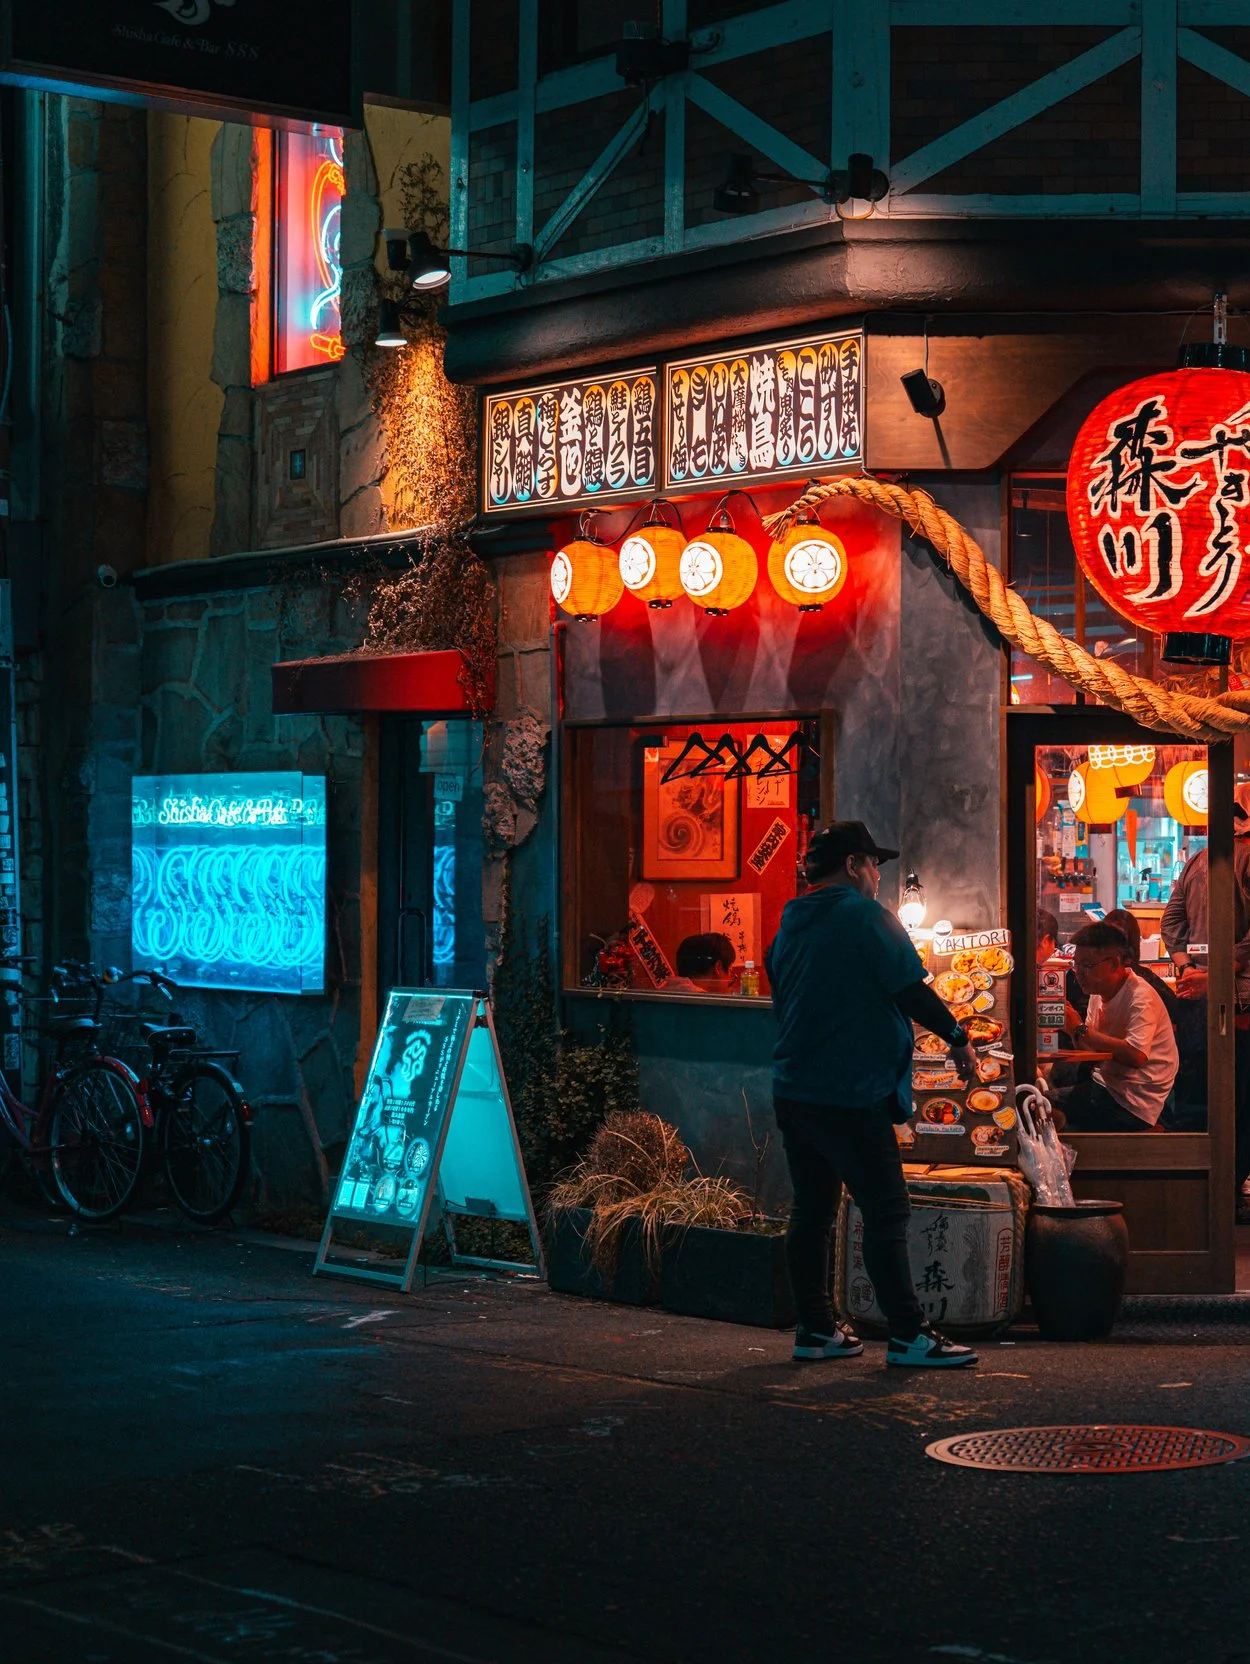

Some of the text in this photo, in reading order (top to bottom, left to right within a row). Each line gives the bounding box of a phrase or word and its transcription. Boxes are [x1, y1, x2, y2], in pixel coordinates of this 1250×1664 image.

[111, 23, 152, 42] Shisha
[538, 395, 557, 495] 梅としらす
[559, 387, 583, 496] 釜めし
[609, 385, 628, 485] 鮭とイクラ
[633, 379, 653, 481] 鶏五目
[750, 354, 776, 470] 焼鳥
[798, 355, 816, 459] こころ
[841, 341, 859, 454] 手羽先
[492, 404, 512, 500] 銀シャリ
[514, 402, 534, 496] 真鯛
[1090, 398, 1203, 601] 森川
[159, 797, 206, 824] Shisha
[438, 780, 460, 796] open
[934, 930, 1008, 952] YAKITORI
[1039, 1004, 1064, 1012] インボイス
[915, 1260, 956, 1322] 森川
